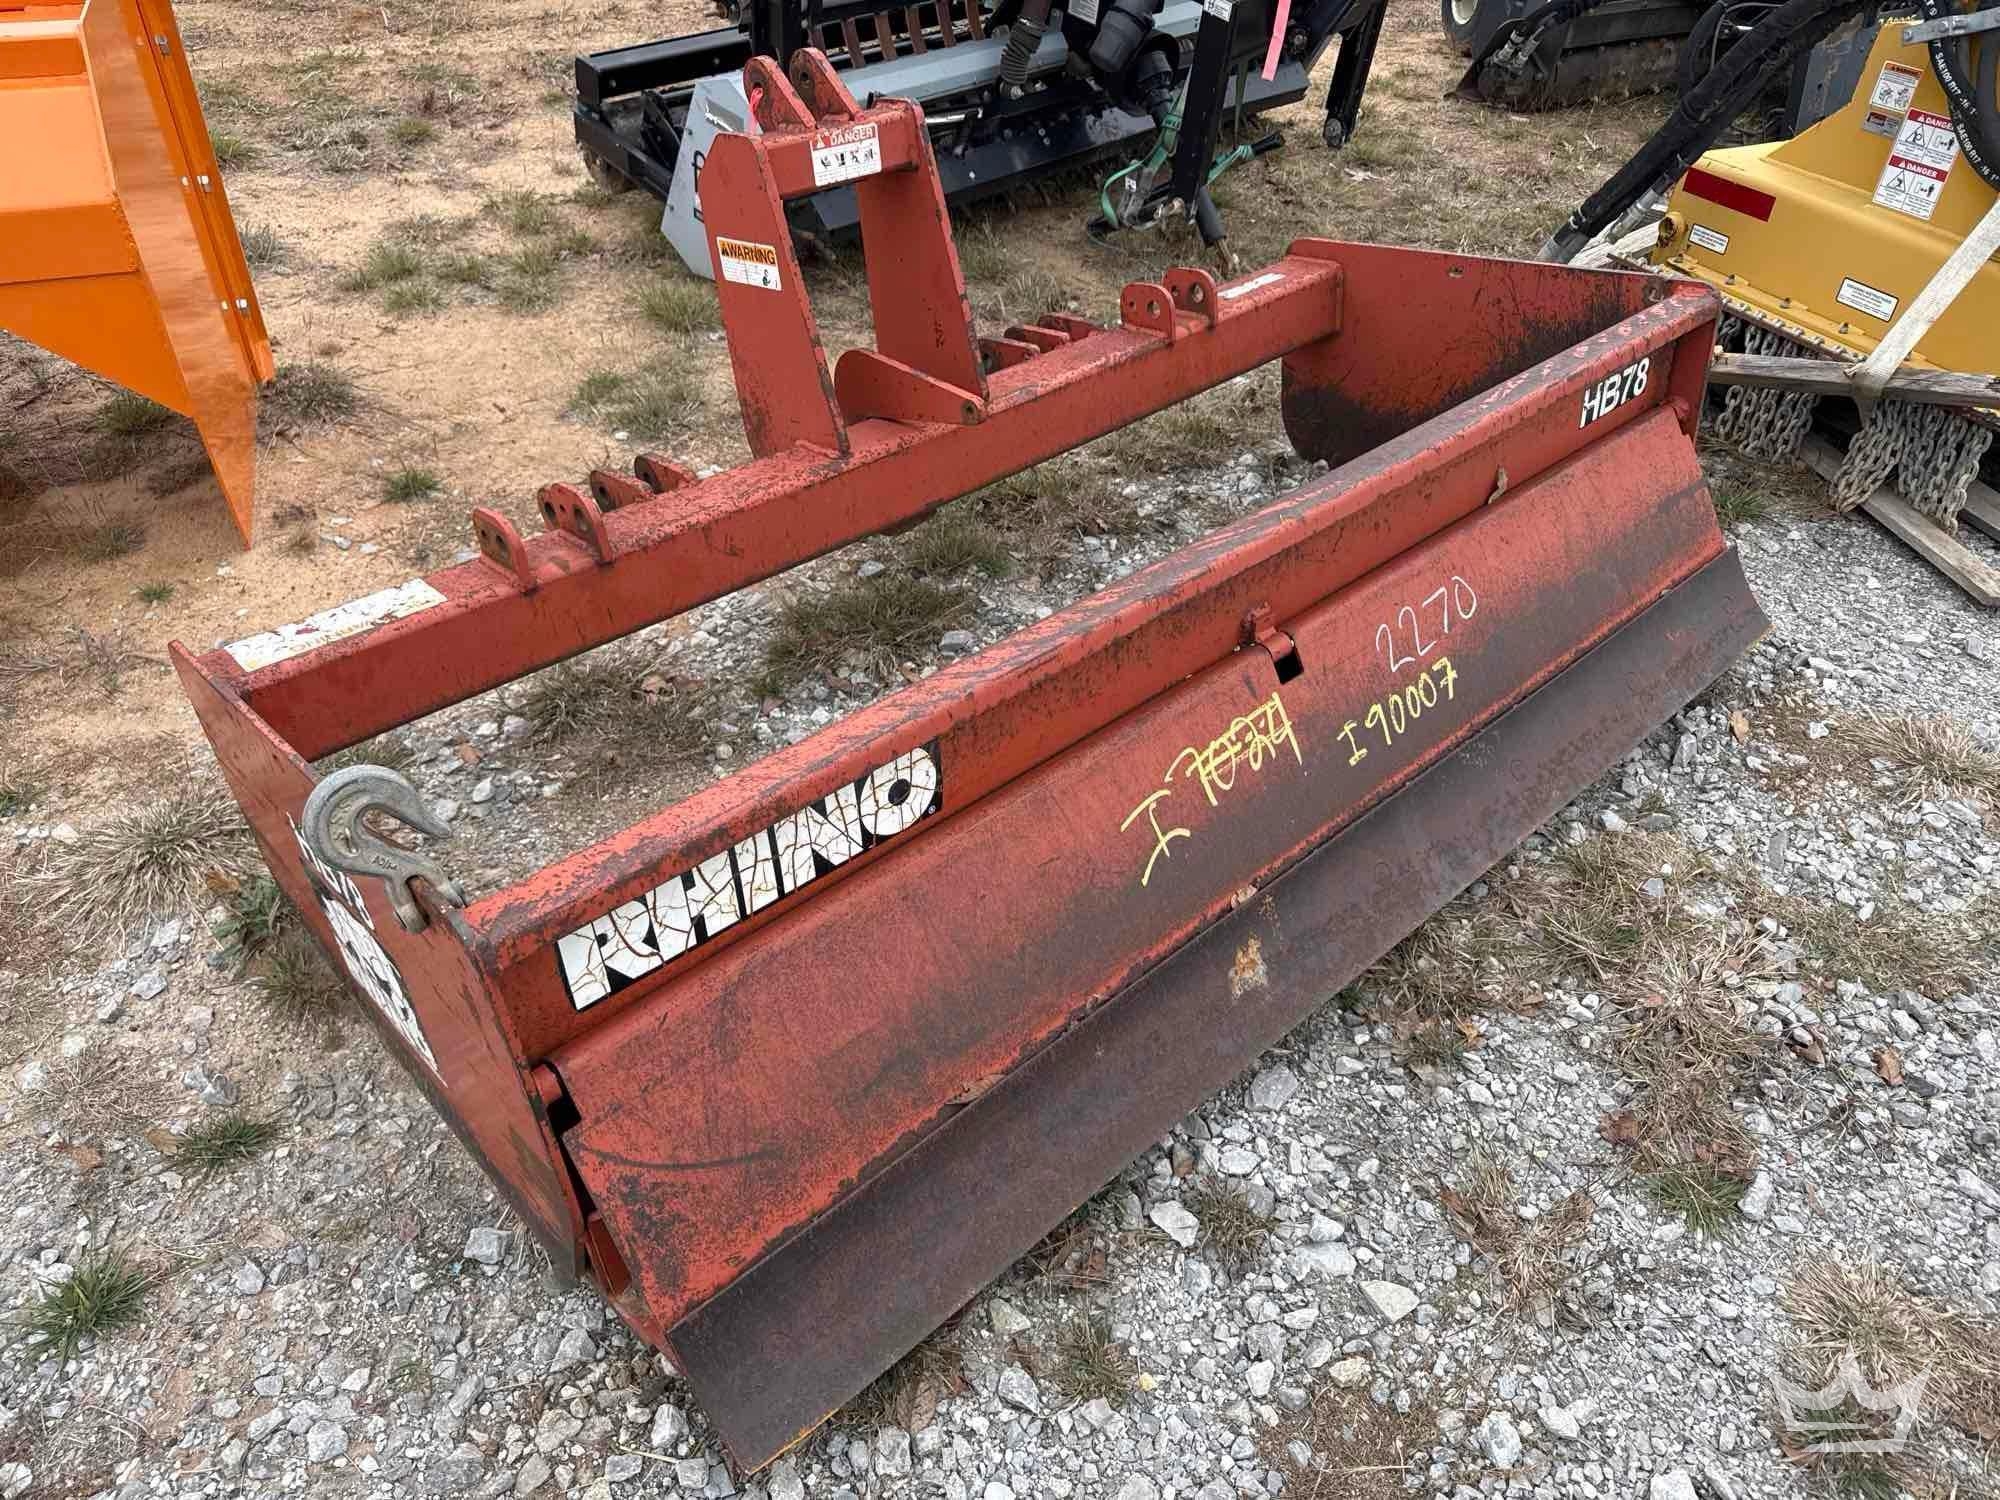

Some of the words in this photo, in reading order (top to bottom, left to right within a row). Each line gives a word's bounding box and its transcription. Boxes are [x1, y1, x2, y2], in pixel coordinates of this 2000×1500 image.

[1925, 117, 1954, 130] DANGE
[831, 127, 873, 145] DANGER
[1906, 162, 1939, 178] DANGER
[727, 242, 776, 265] WARNING
[1580, 357, 1650, 428] HB78
[1376, 576, 1477, 672] 2270
[557, 747, 937, 1011] RHINO
